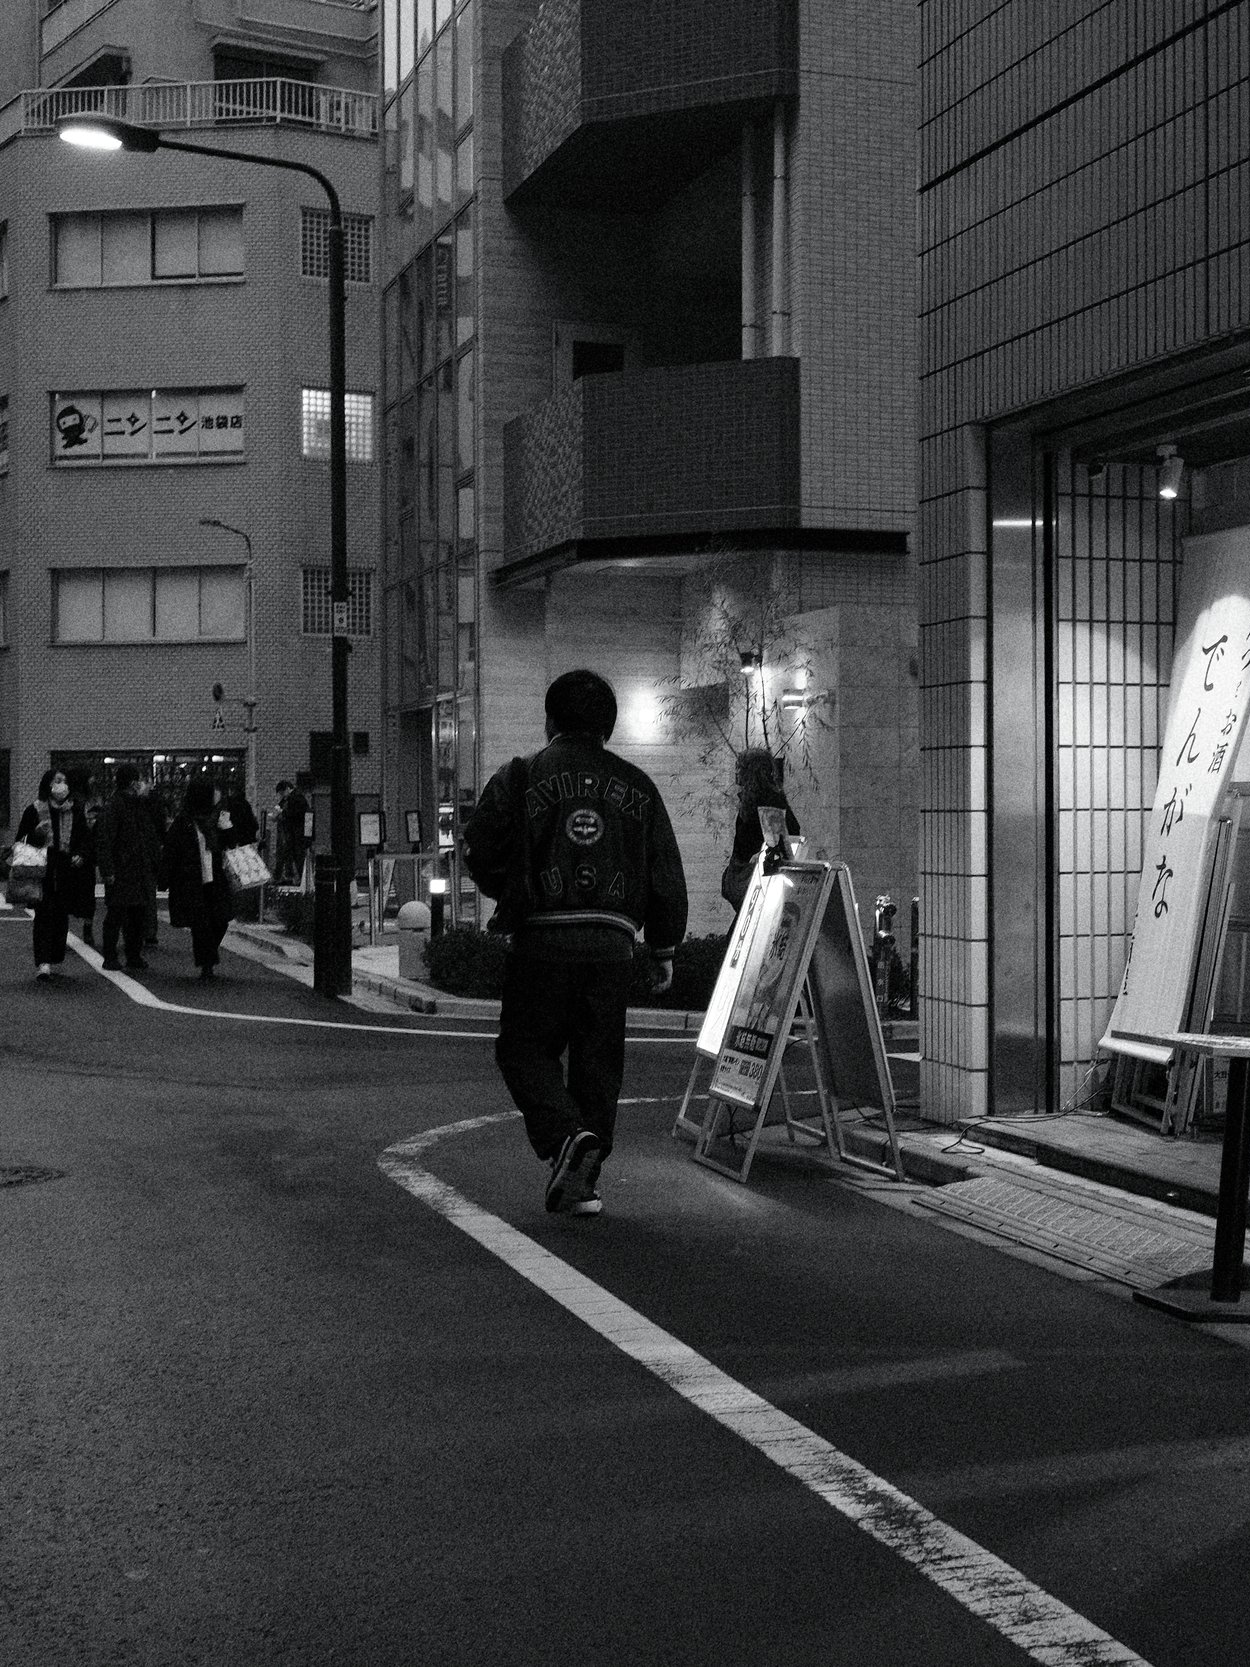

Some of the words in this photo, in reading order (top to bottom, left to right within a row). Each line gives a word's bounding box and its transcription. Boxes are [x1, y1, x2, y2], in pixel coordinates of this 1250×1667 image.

[525, 771, 650, 820] AVIREX
[1152, 635, 1228, 919] でんがな
[540, 863, 625, 899] USA
